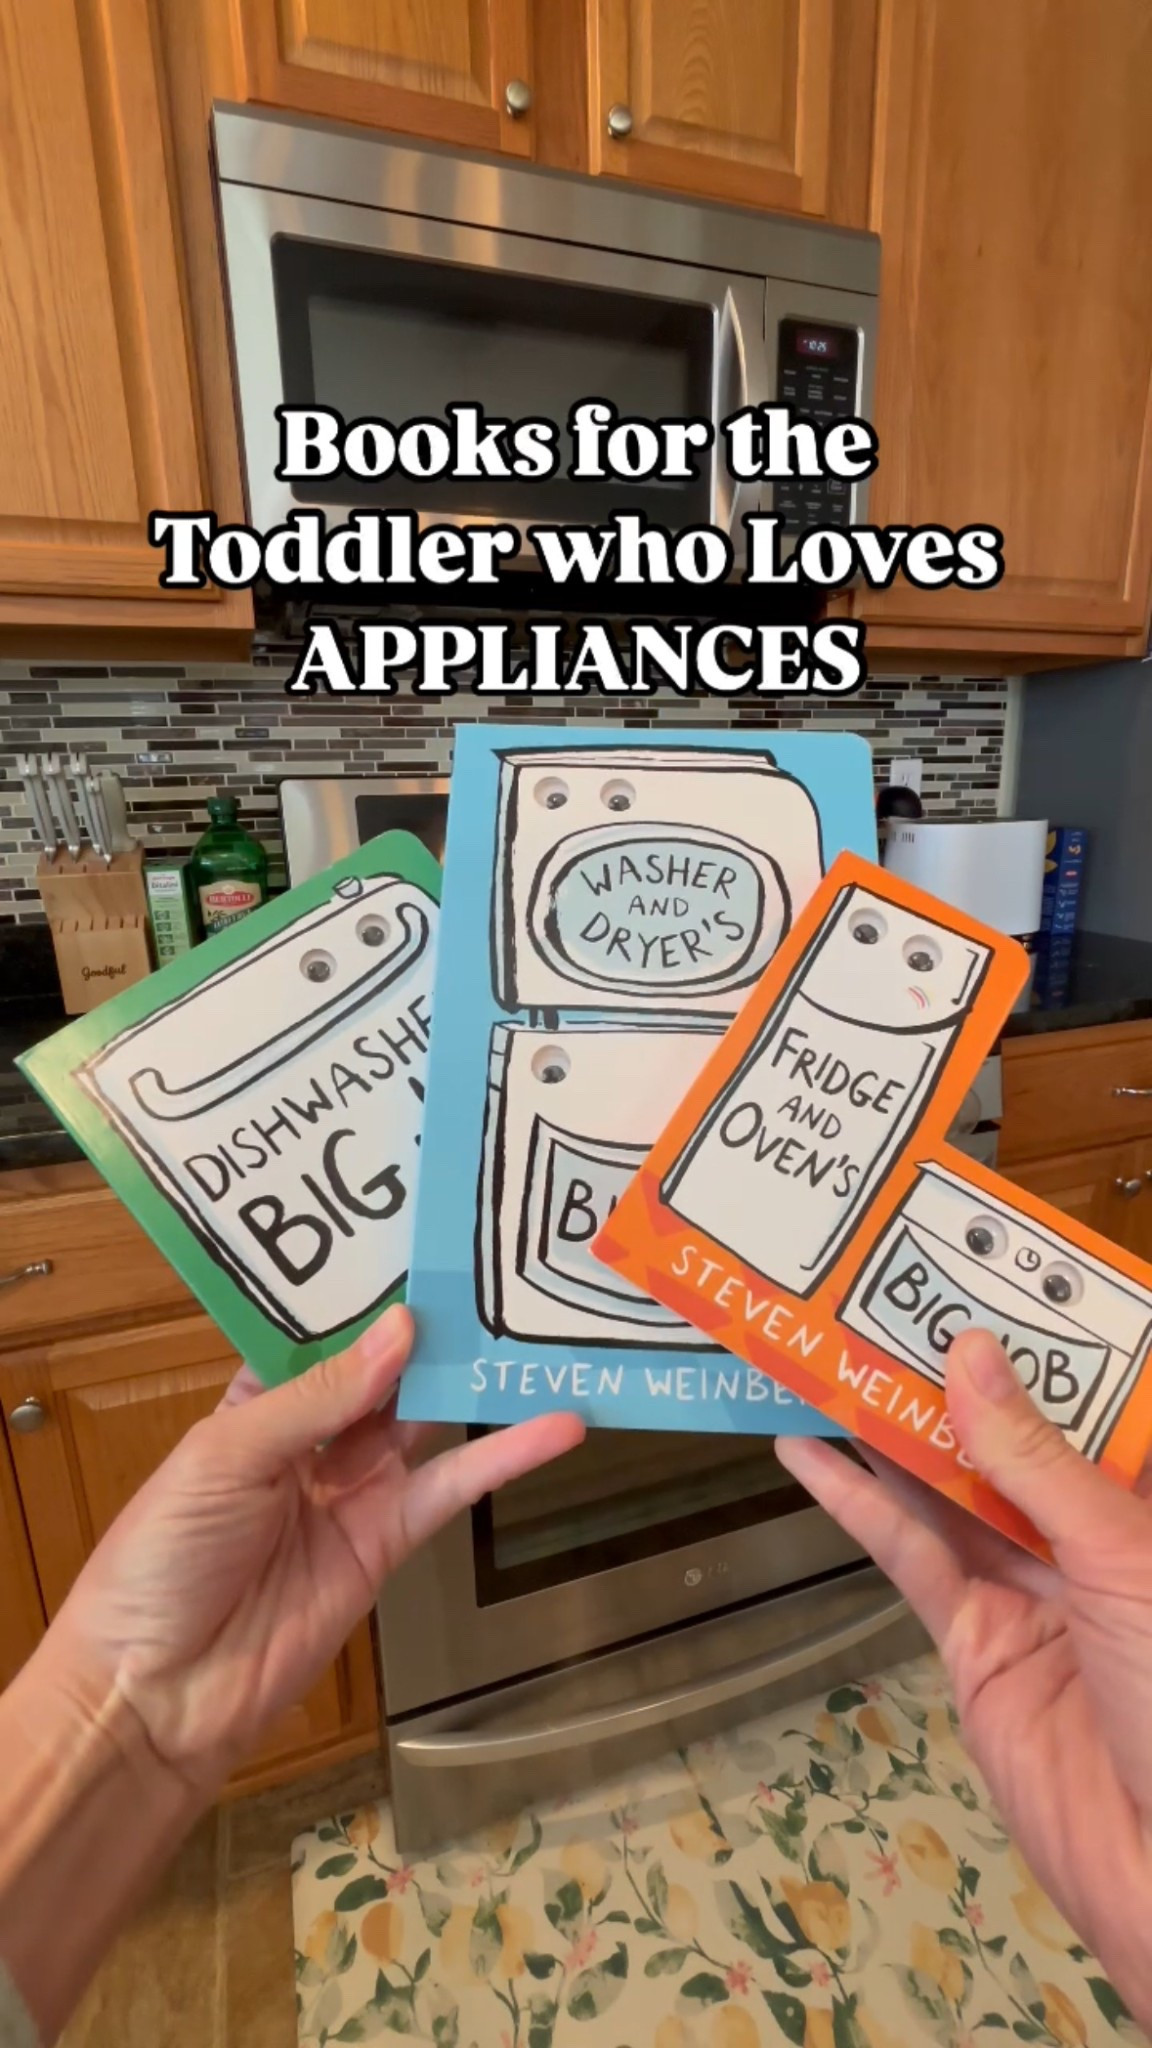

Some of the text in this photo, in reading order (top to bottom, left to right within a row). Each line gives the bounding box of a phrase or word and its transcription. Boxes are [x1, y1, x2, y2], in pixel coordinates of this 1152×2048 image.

[579, 853, 738, 900] WASHER
[627, 894, 690, 918] AND
[579, 910, 745, 969] DRYER'S
[770, 1026, 907, 1115] FRIDGE
[719, 1101, 861, 1198] OVEN'S
[776, 1094, 842, 1140] AND
[237, 1127, 408, 1288] BIG
[670, 1244, 825, 1358] STEVEN
[882, 1260, 1080, 1404] BIG OB
[469, 1358, 806, 1407] STEVEN WEINBE
